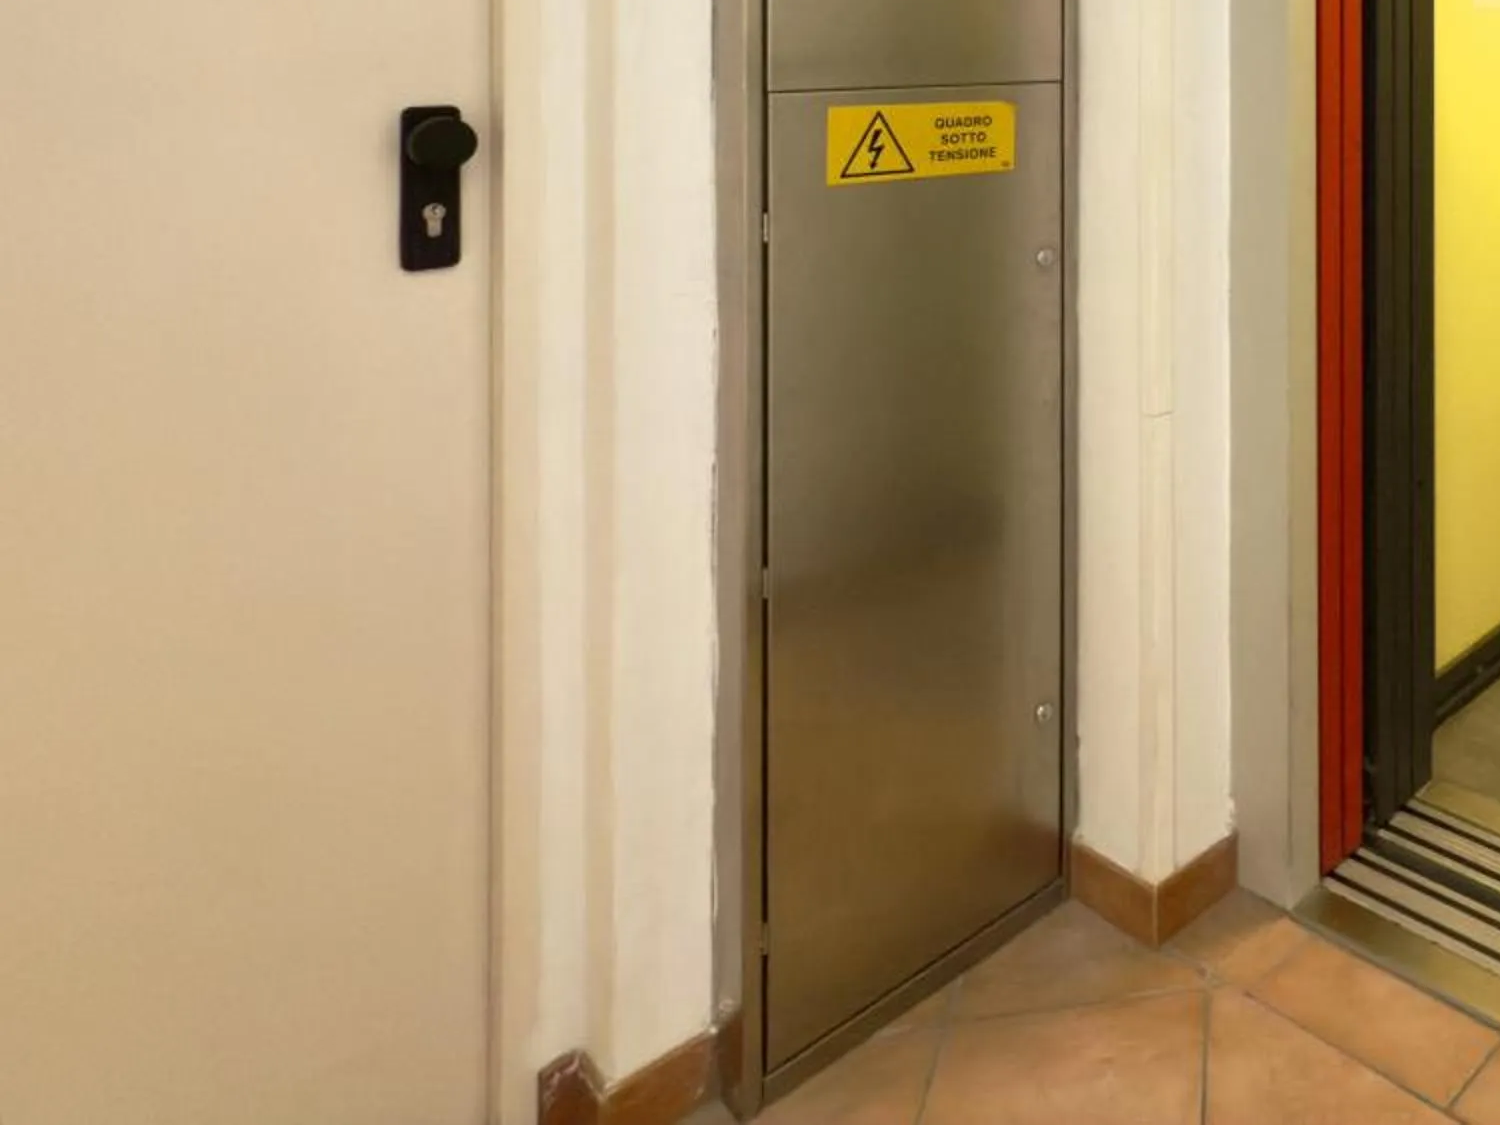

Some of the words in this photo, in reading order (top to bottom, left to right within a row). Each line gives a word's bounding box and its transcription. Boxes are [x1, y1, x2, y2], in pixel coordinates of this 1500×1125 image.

[934, 115, 993, 130] QUADRO
[941, 131, 987, 145] SOTTO
[928, 146, 997, 162] TENSIONE
